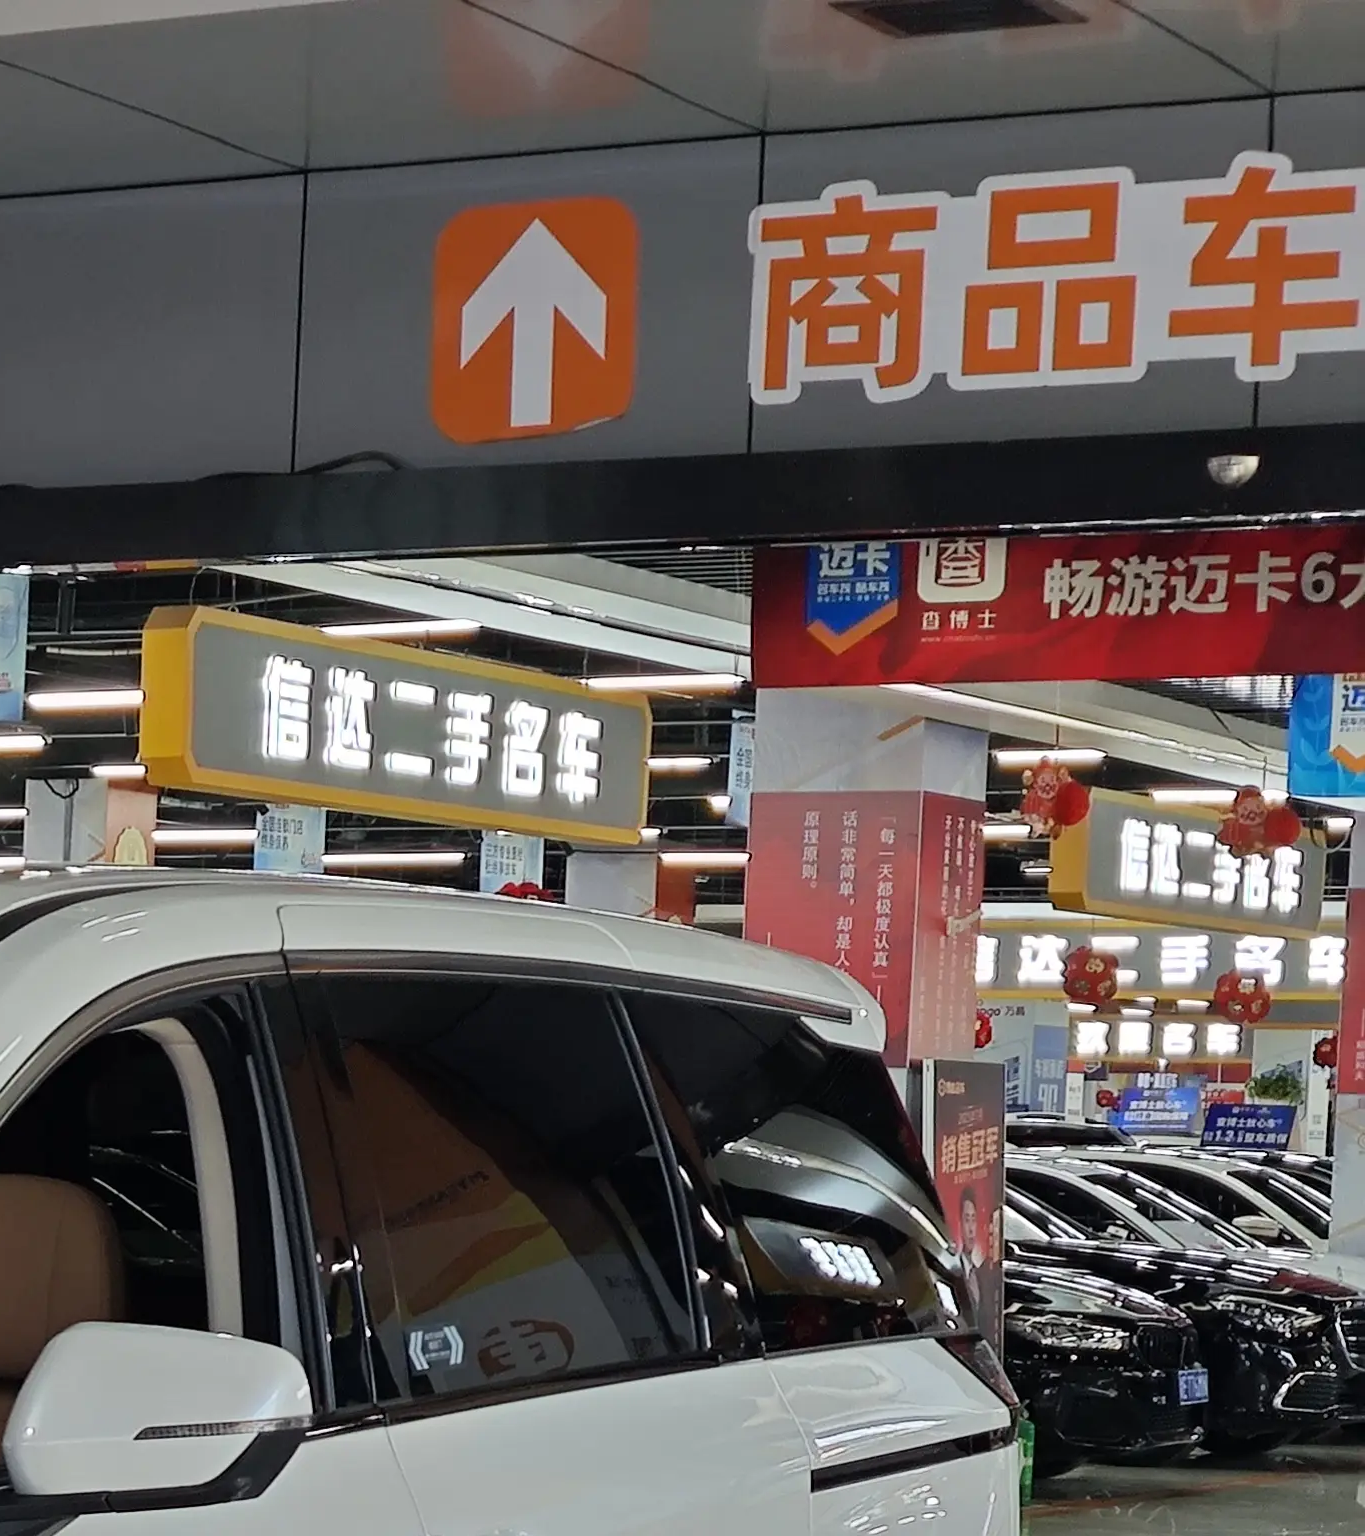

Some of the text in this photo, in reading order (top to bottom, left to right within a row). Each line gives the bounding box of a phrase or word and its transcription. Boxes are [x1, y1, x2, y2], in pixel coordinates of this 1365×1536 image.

[757, 163, 1361, 395] 商品车
[818, 540, 892, 578] 迈卡
[921, 608, 997, 631] 查博士
[263, 655, 604, 803] 信达二手名车
[834, 811, 859, 976] 话非常简单，却是人
[941, 1126, 999, 1174] 销售冠军
